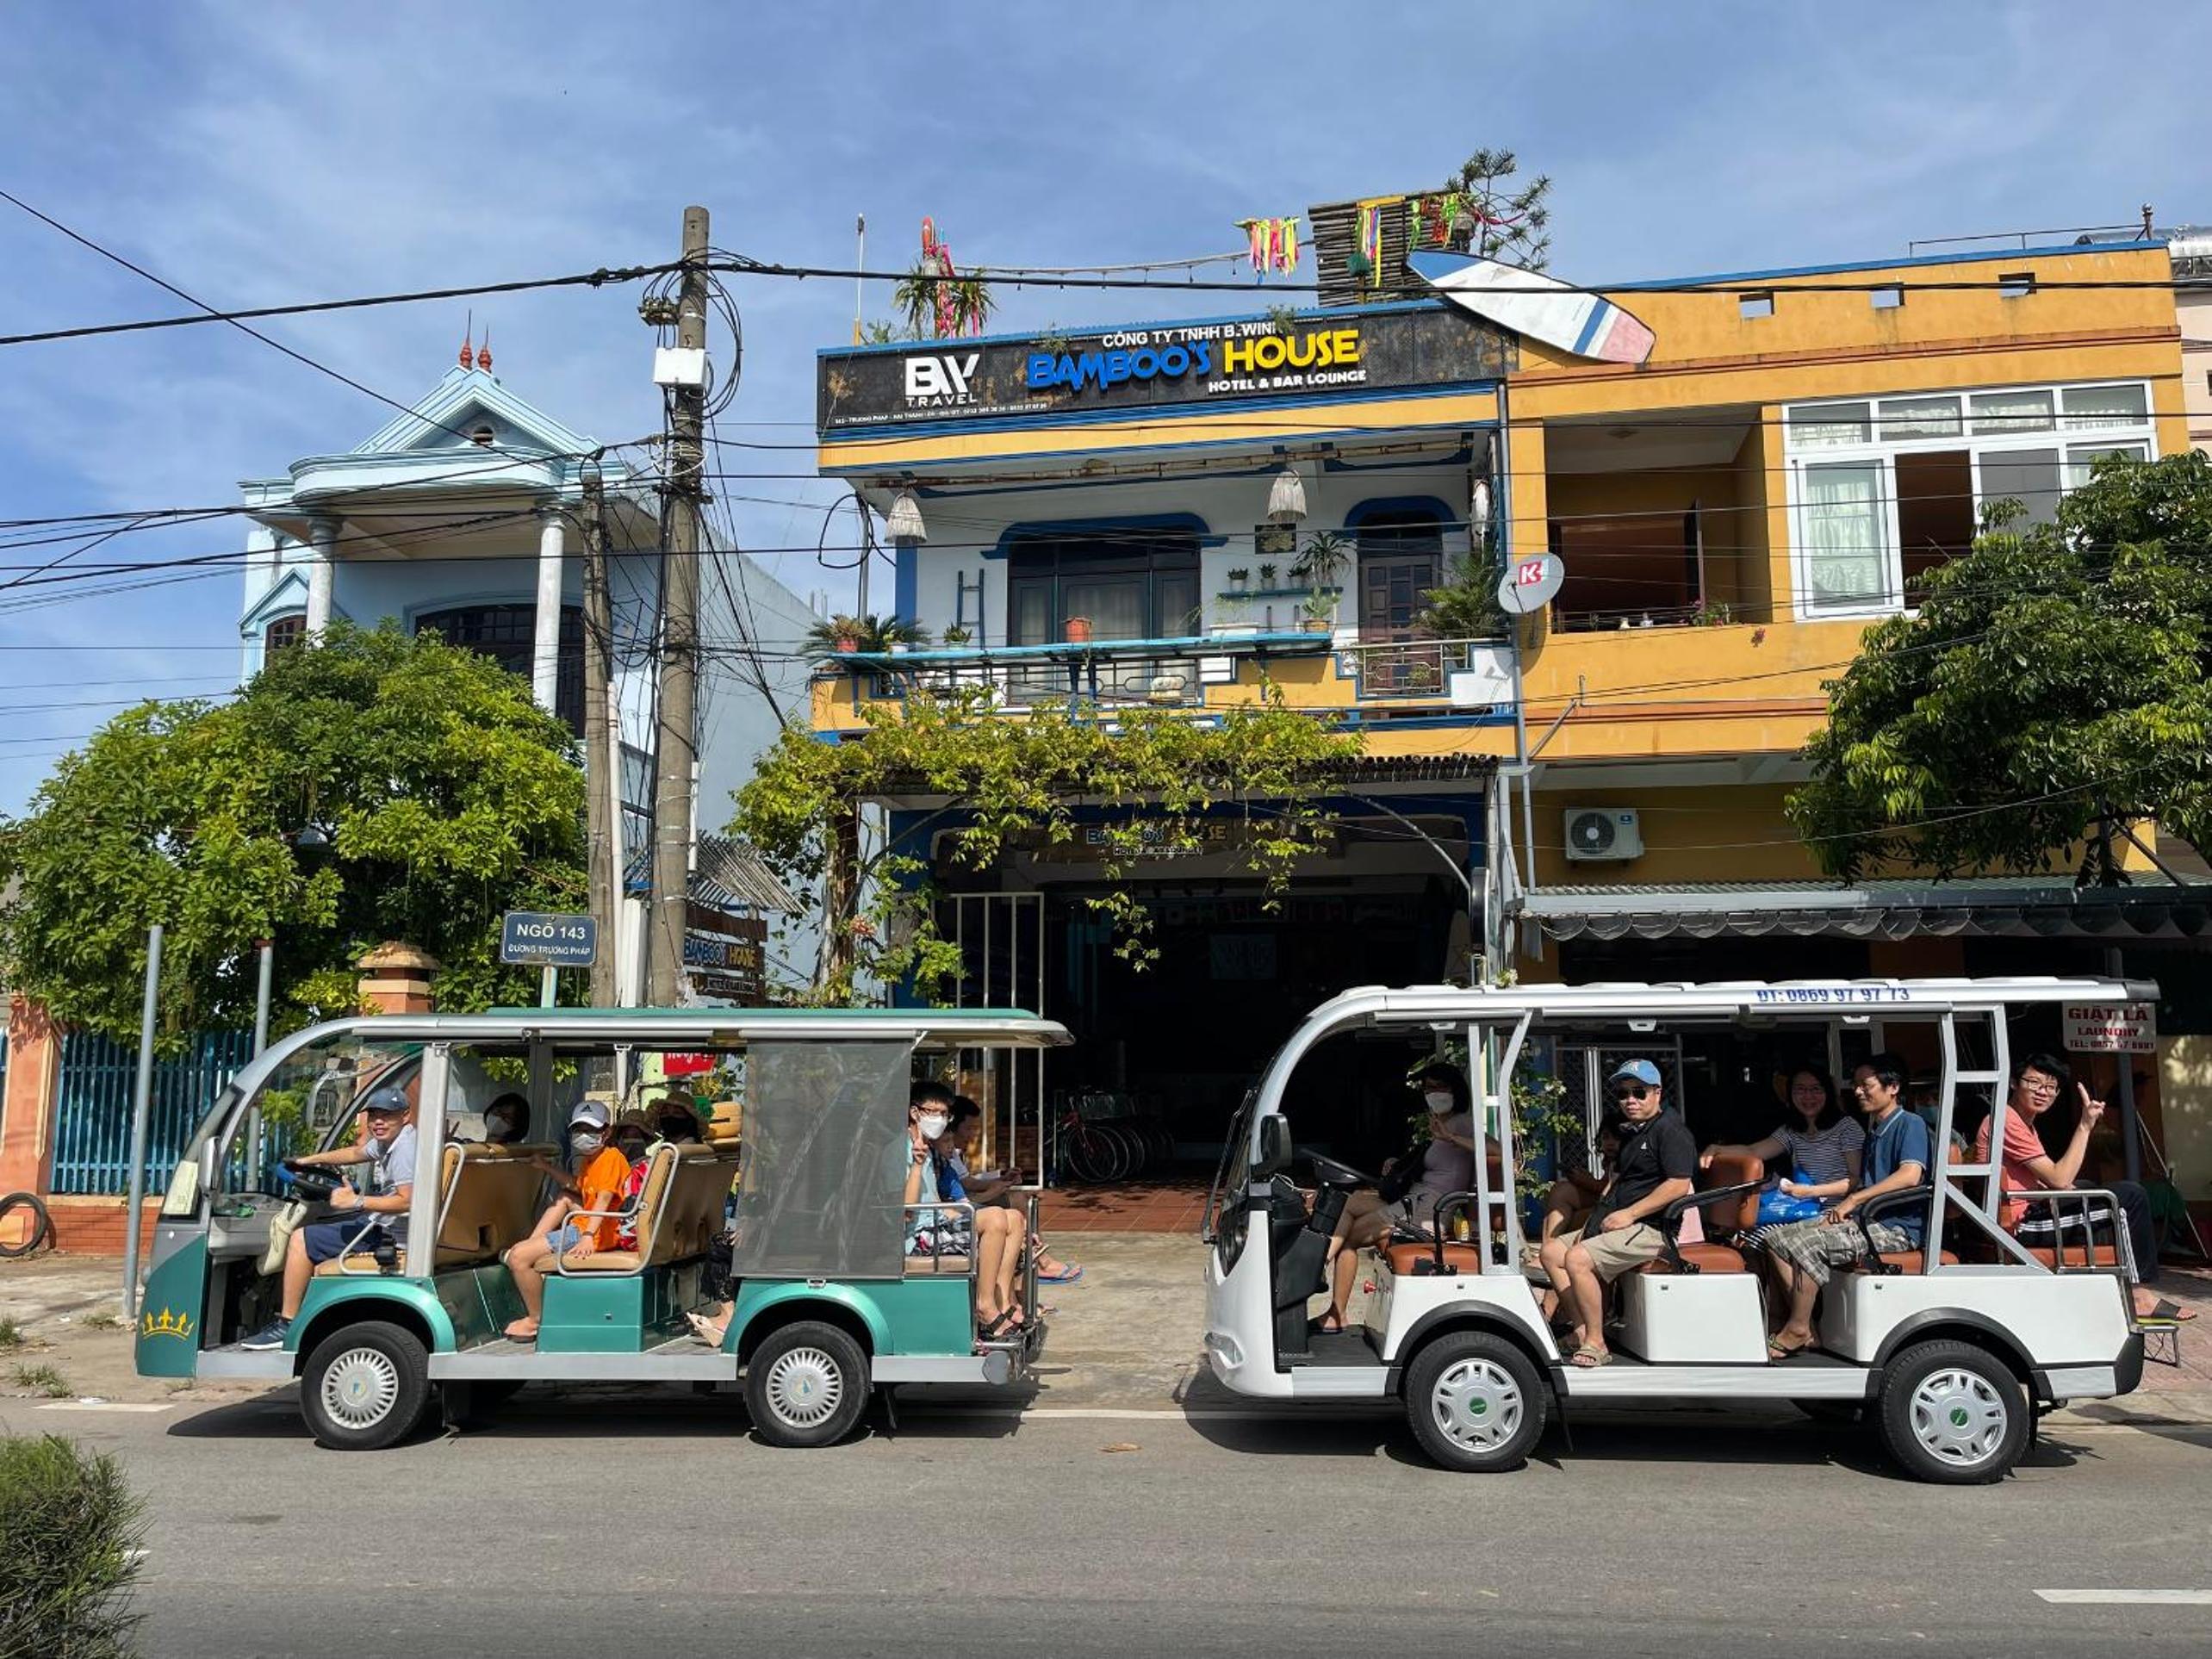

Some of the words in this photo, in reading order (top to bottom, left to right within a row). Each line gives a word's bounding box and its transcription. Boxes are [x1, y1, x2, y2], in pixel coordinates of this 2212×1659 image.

[1103, 331, 1148, 347] CÔNG
[1153, 330, 1173, 343] TY
[1179, 326, 1221, 341] TNHH
[1027, 339, 1211, 391] BAMBOO'S
[1225, 329, 1360, 373] HOUSE
[1209, 377, 1256, 392] HOTEL
[1258, 377, 1270, 388] &
[1273, 374, 1303, 387] BAR
[1307, 370, 1367, 384] LOUNGE
[905, 393, 979, 407] TRAVEL
[517, 923, 555, 938] NGÕ
[560, 926, 586, 940] 143
[1786, 989, 1830, 1003] 0869
[1834, 988, 1854, 1002] 97
[1861, 988, 1881, 1002] 97
[1886, 987, 1911, 1001] 73
[2077, 1027, 2140, 1037] LAUNDRY
[2069, 1039, 2089, 1048] TEL:
